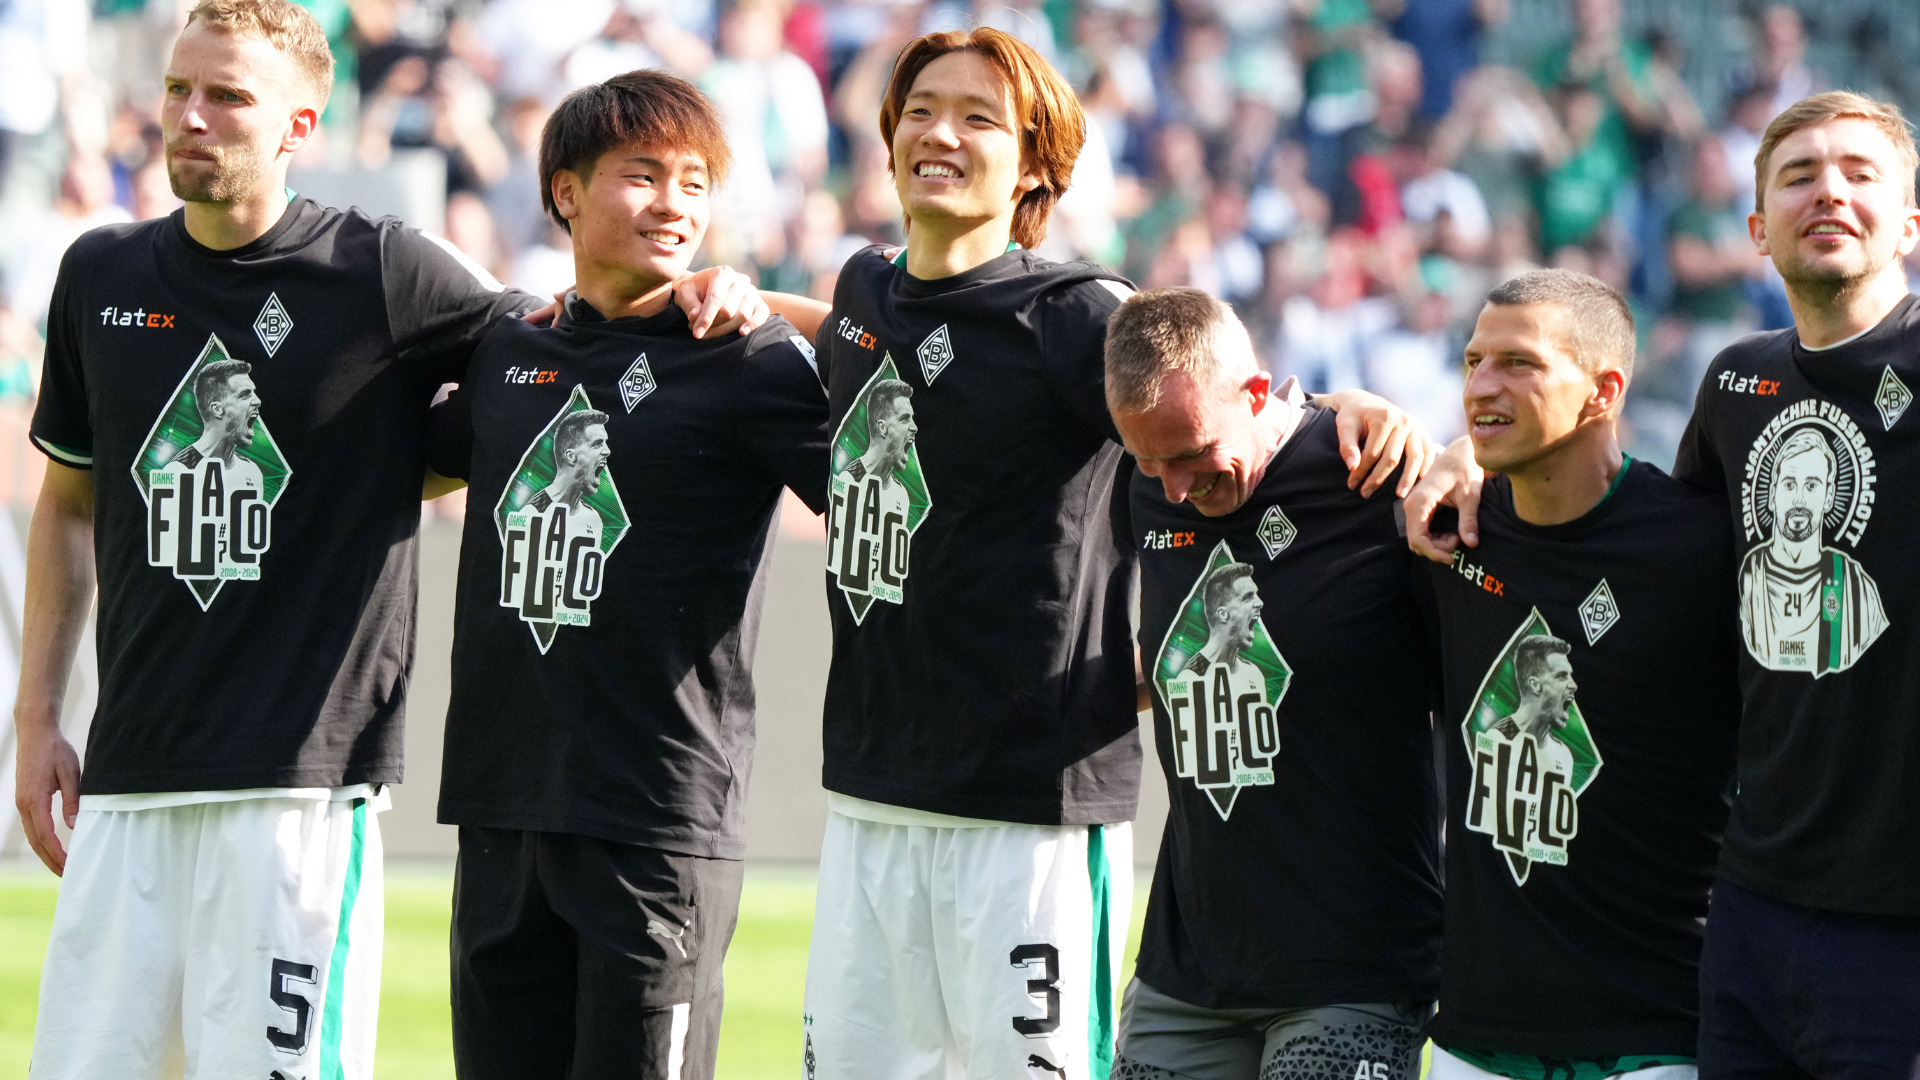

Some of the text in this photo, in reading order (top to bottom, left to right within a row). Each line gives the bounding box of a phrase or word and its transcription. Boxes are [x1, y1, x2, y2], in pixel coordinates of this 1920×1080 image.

[152, 472, 174, 485] DANKE
[1742, 399, 1877, 548] TONY JANTSCHKE FUSSBALLGOTT
[1784, 593, 1802, 617] 24
[1780, 641, 1806, 655] DANKE
[1170, 682, 1188, 694] DANKE
[1010, 943, 1065, 1039] 3
[266, 957, 318, 1056] 5
[1354, 1060, 1389, 1080] AS
